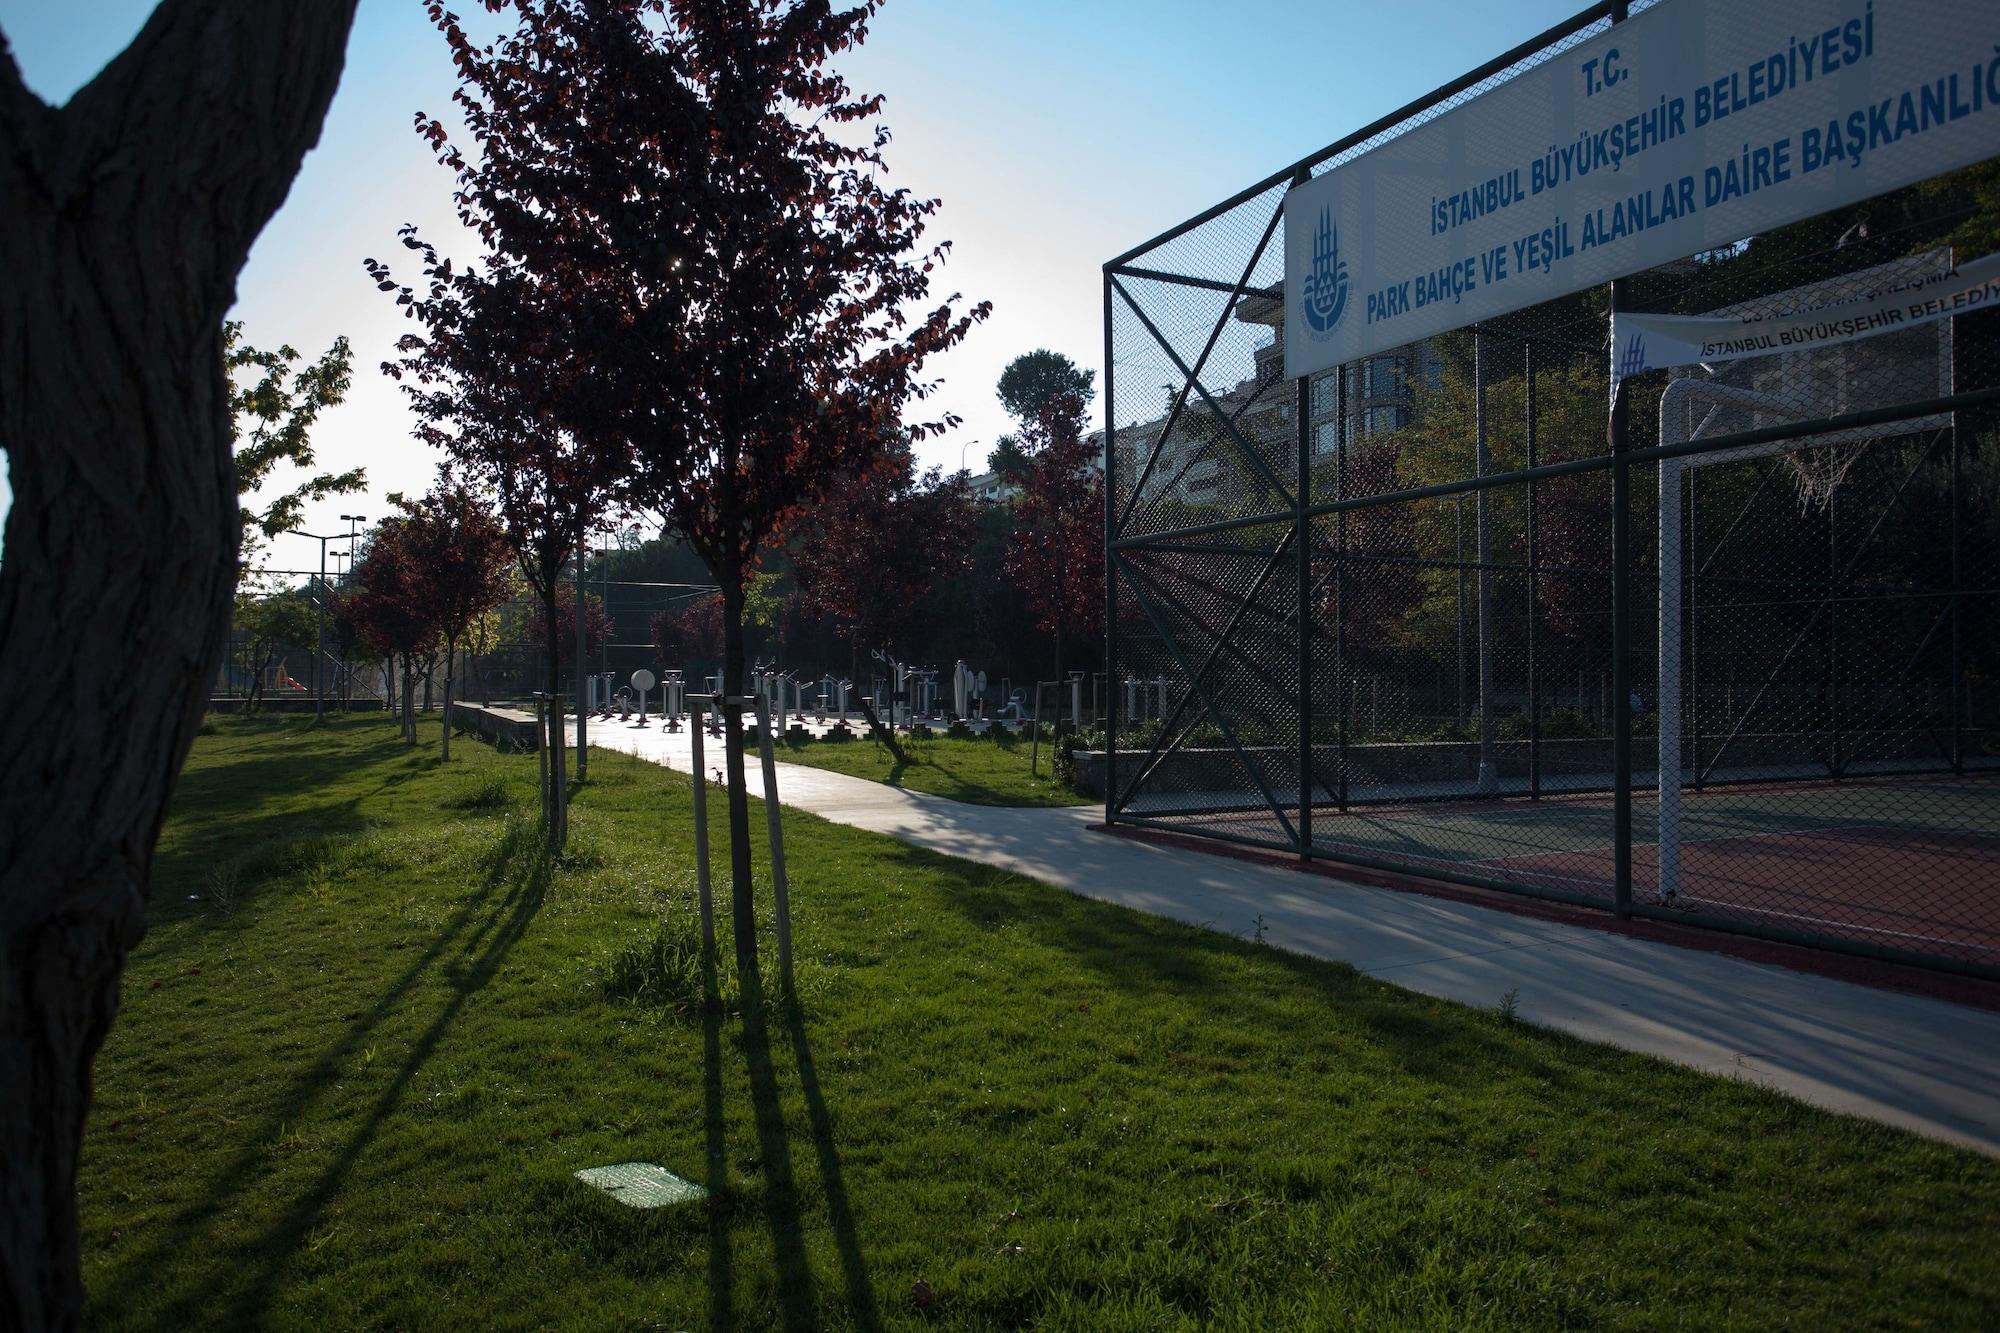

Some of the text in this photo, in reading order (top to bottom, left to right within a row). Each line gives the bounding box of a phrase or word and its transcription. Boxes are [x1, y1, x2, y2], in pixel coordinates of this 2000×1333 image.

[1431, 1, 1874, 236] İSTANBUL BÜYÜKŞEHİR BELEDİYESİ
[1581, 48, 1629, 97] T.C.
[1367, 281, 1410, 325] PARK
[1415, 257, 1476, 308] BAHÇE
[1481, 245, 1507, 285] VE
[1513, 216, 1575, 274] YEŞİL
[1581, 175, 1697, 251] ALANLAR
[1704, 143, 1792, 208] DAİRE
[1700, 334, 1778, 357] İSTANBUL
[1781, 308, 1903, 347] BÜYÜKŞEHİR
